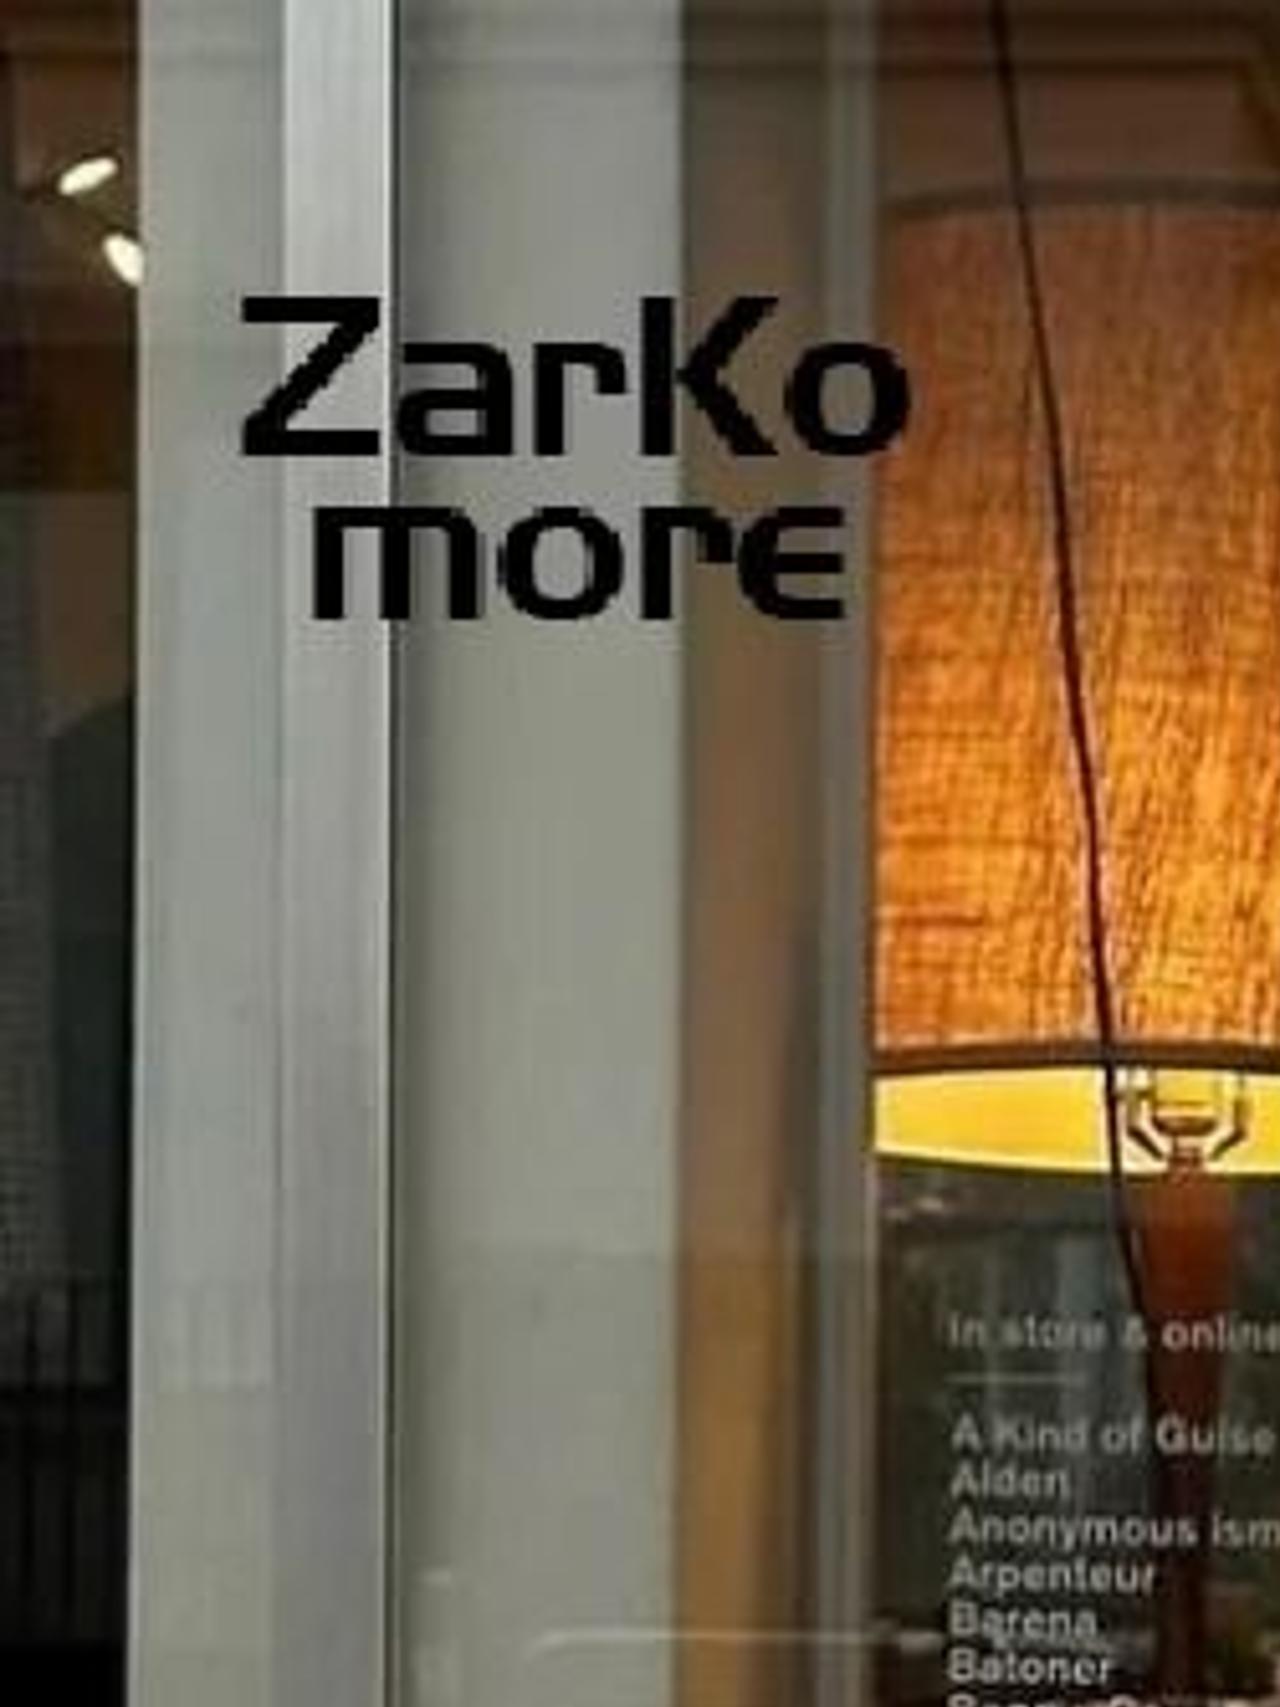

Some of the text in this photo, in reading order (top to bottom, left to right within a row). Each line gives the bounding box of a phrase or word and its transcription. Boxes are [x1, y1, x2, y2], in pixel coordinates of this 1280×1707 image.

[951, 1412, 981, 1451] A
[1101, 1412, 1143, 1452] of
[1155, 1411, 1277, 1453] Guise
[950, 1459, 1071, 1498] Alden
[949, 1505, 1199, 1553] Anonymous
[949, 1553, 1156, 1598] Arpenteur
[949, 1601, 1099, 1638] Barena
